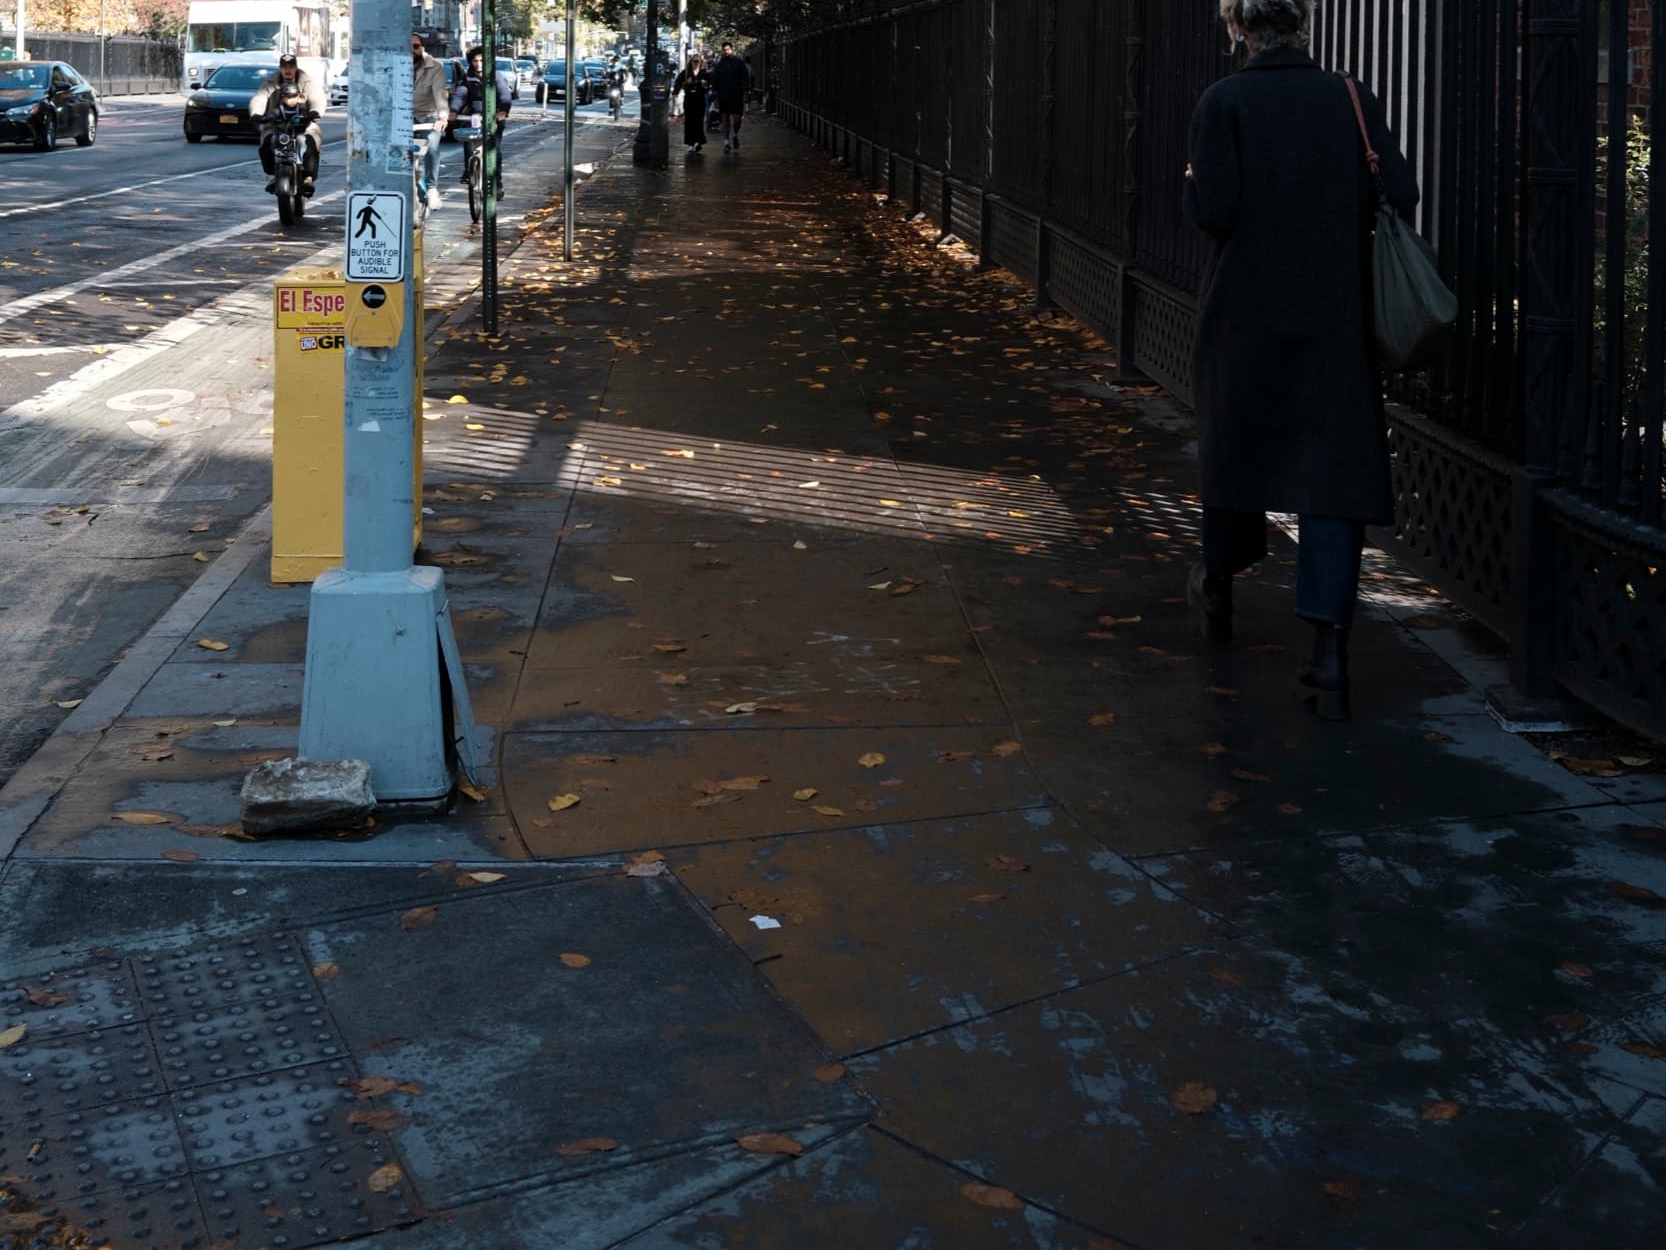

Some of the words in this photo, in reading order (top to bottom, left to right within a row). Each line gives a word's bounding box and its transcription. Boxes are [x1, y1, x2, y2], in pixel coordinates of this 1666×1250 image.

[364, 240, 387, 248] PUSH
[351, 248, 382, 257] BUTTON
[383, 249, 399, 258] FOR
[358, 257, 393, 266] AUDIBLE
[360, 265, 389, 274] SIGNAL
[280, 290, 296, 312] El
[303, 290, 345, 317] Espe
